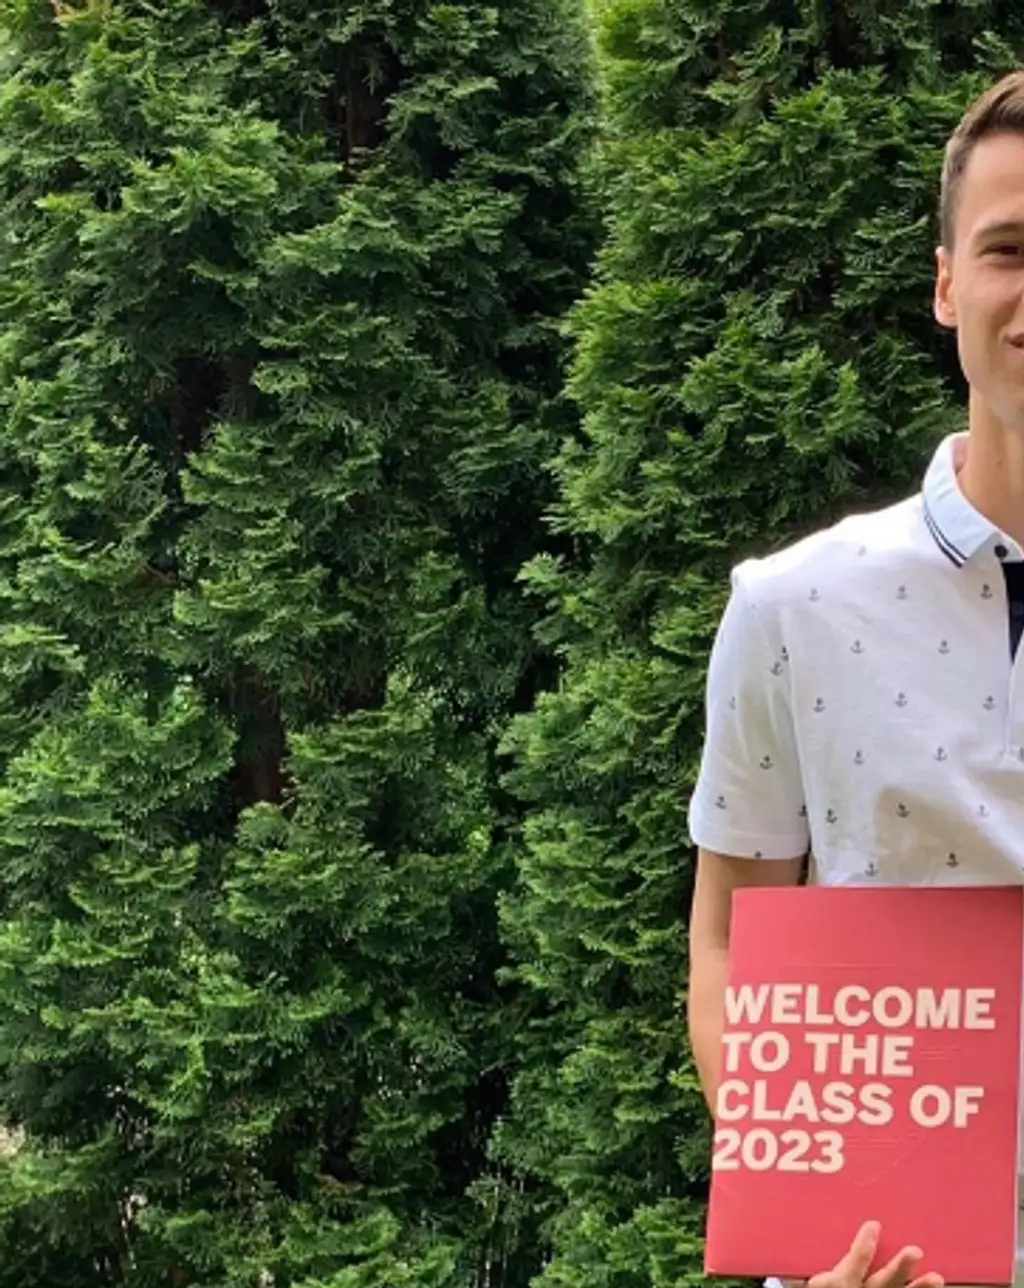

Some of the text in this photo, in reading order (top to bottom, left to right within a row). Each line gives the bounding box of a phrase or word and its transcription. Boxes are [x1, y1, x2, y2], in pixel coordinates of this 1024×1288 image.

[724, 984, 996, 1029] WELCOME
[721, 1031, 914, 1076] TO THE
[715, 1079, 984, 1127] CLASS OF
[712, 1128, 845, 1173] 2023
